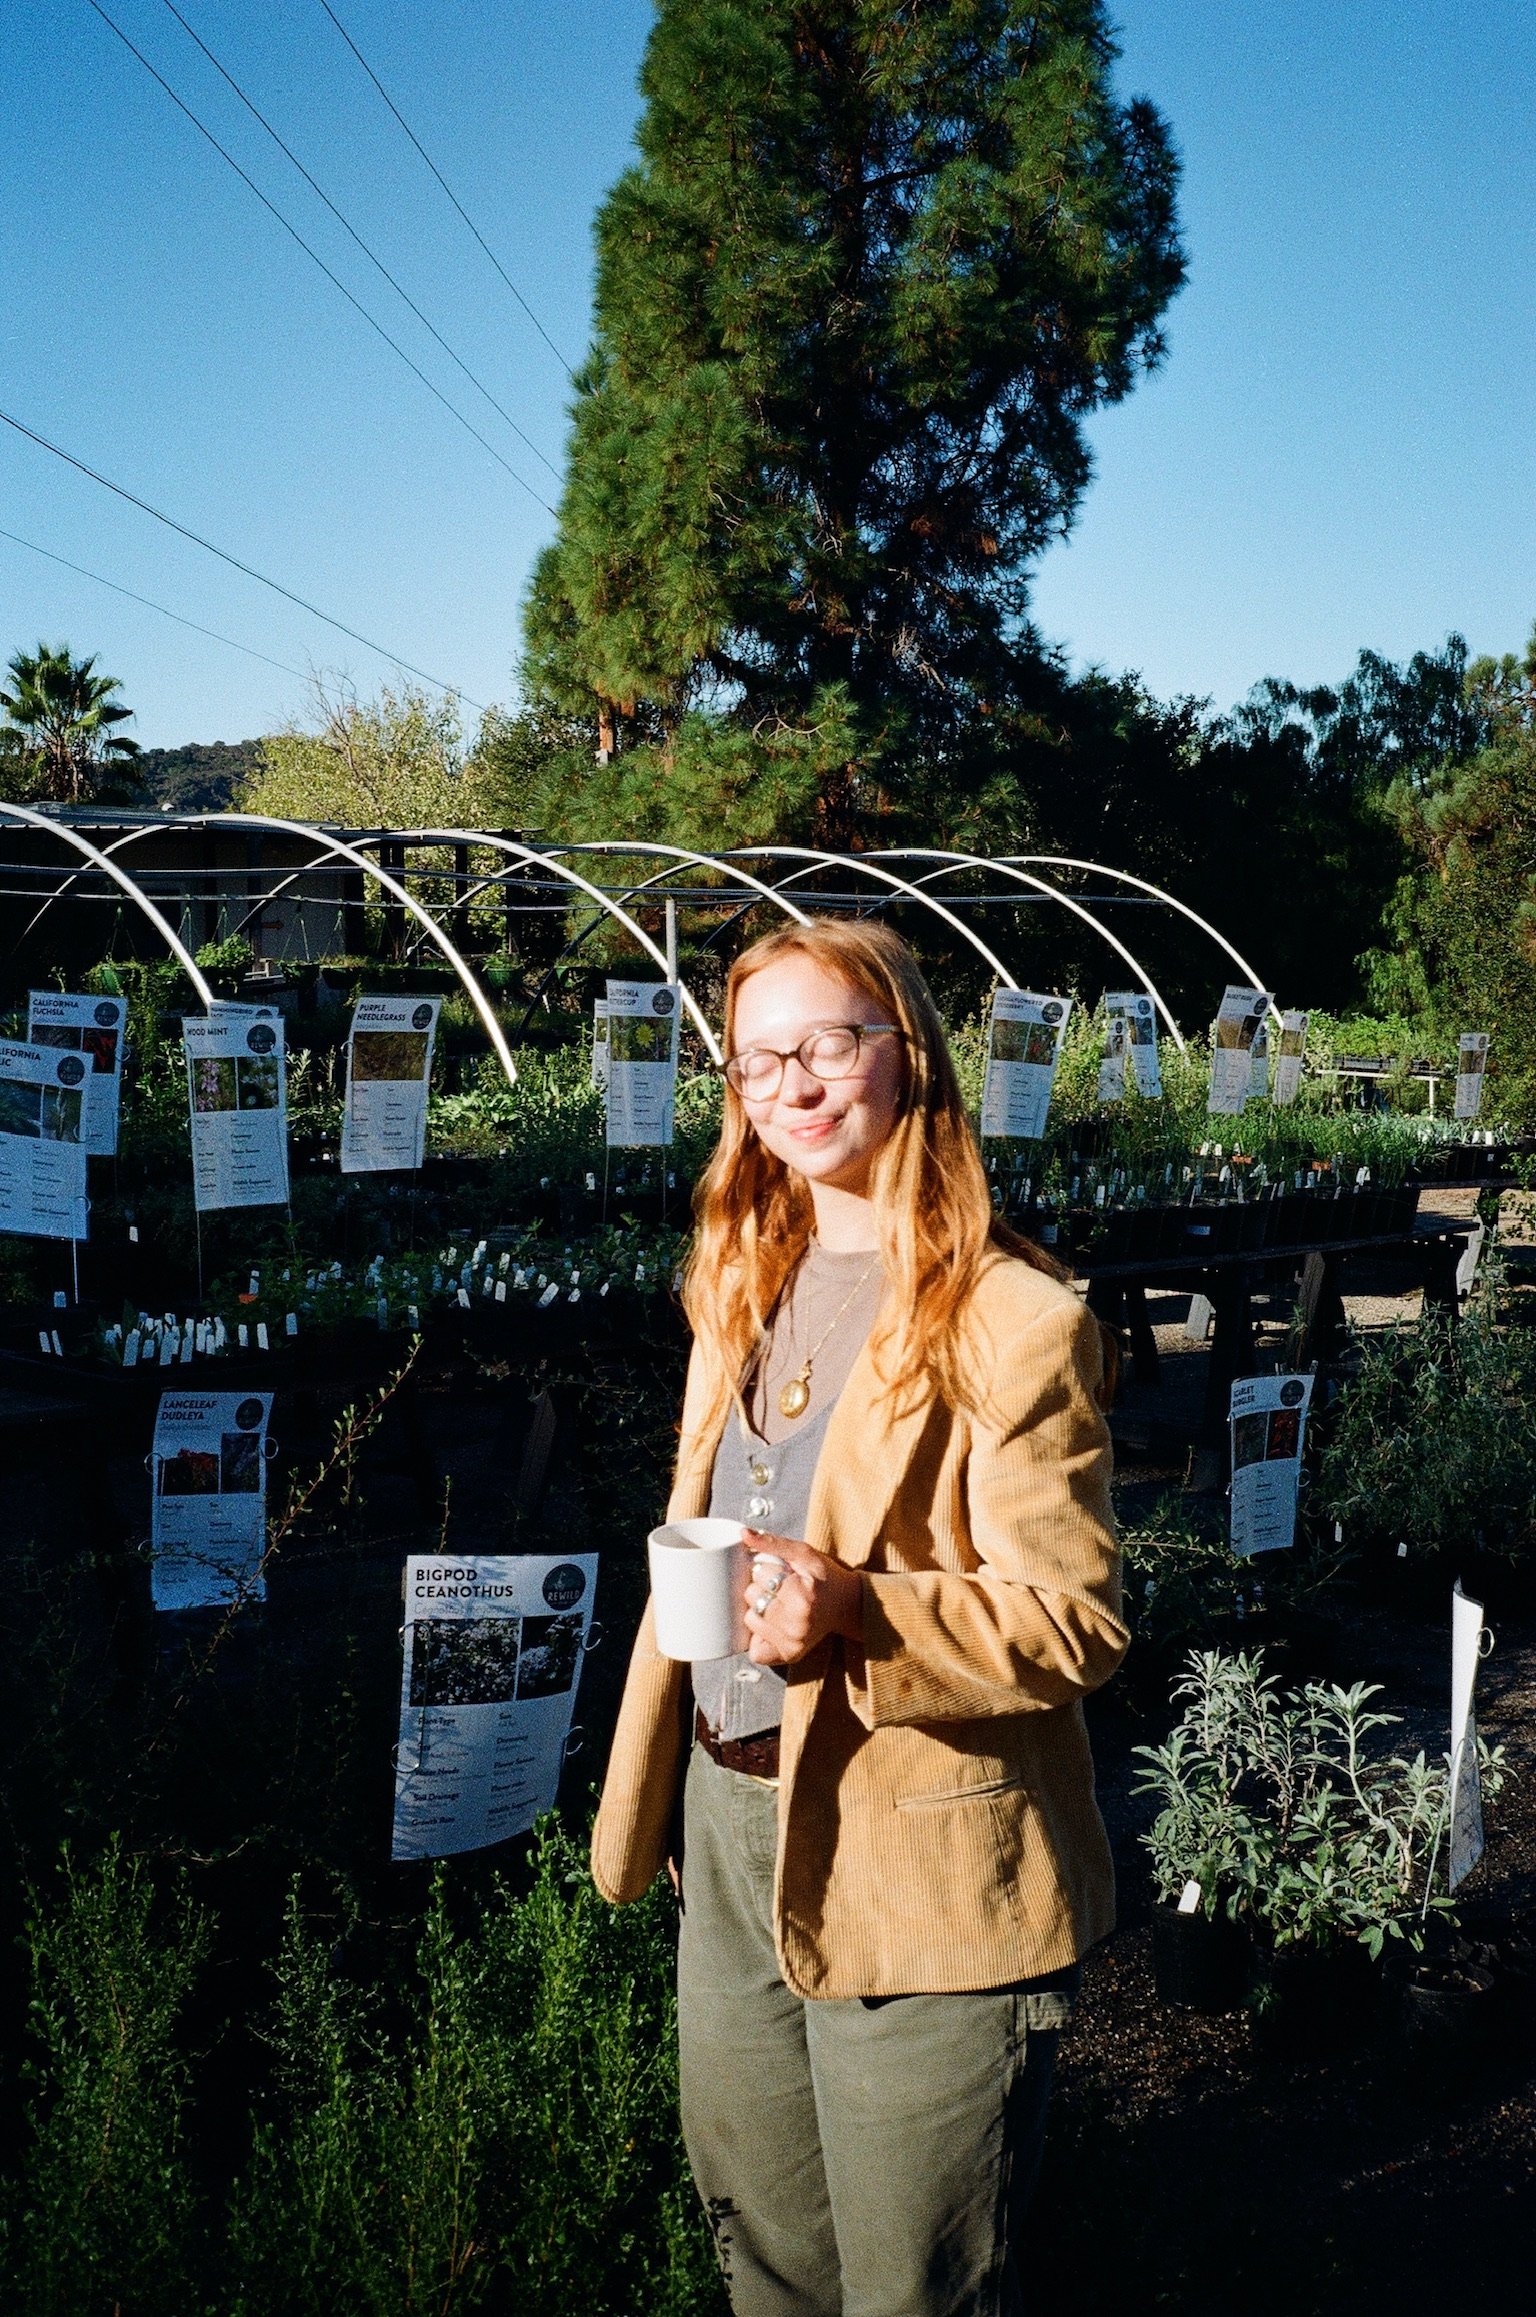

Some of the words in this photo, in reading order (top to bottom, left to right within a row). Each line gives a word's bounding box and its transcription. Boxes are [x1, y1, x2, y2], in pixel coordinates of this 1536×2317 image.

[32, 999, 79, 1009] CALIFORNIA
[359, 1004, 387, 1012] PURPLE
[32, 1007, 65, 1016] FUCHSIA
[356, 1013, 407, 1021] NEEDLEGRASS
[207, 1027, 229, 1036] MINT
[0, 1047, 42, 1061] IFORNIA
[163, 1400, 219, 1410] LANCELEAF
[161, 1411, 205, 1421] DUDLEYA
[416, 1568, 479, 1582] BIGPOD
[415, 1584, 514, 1599] CEANOTHUS
[547, 1590, 581, 1602] REWILD
[438, 1766, 460, 1775] Needs
